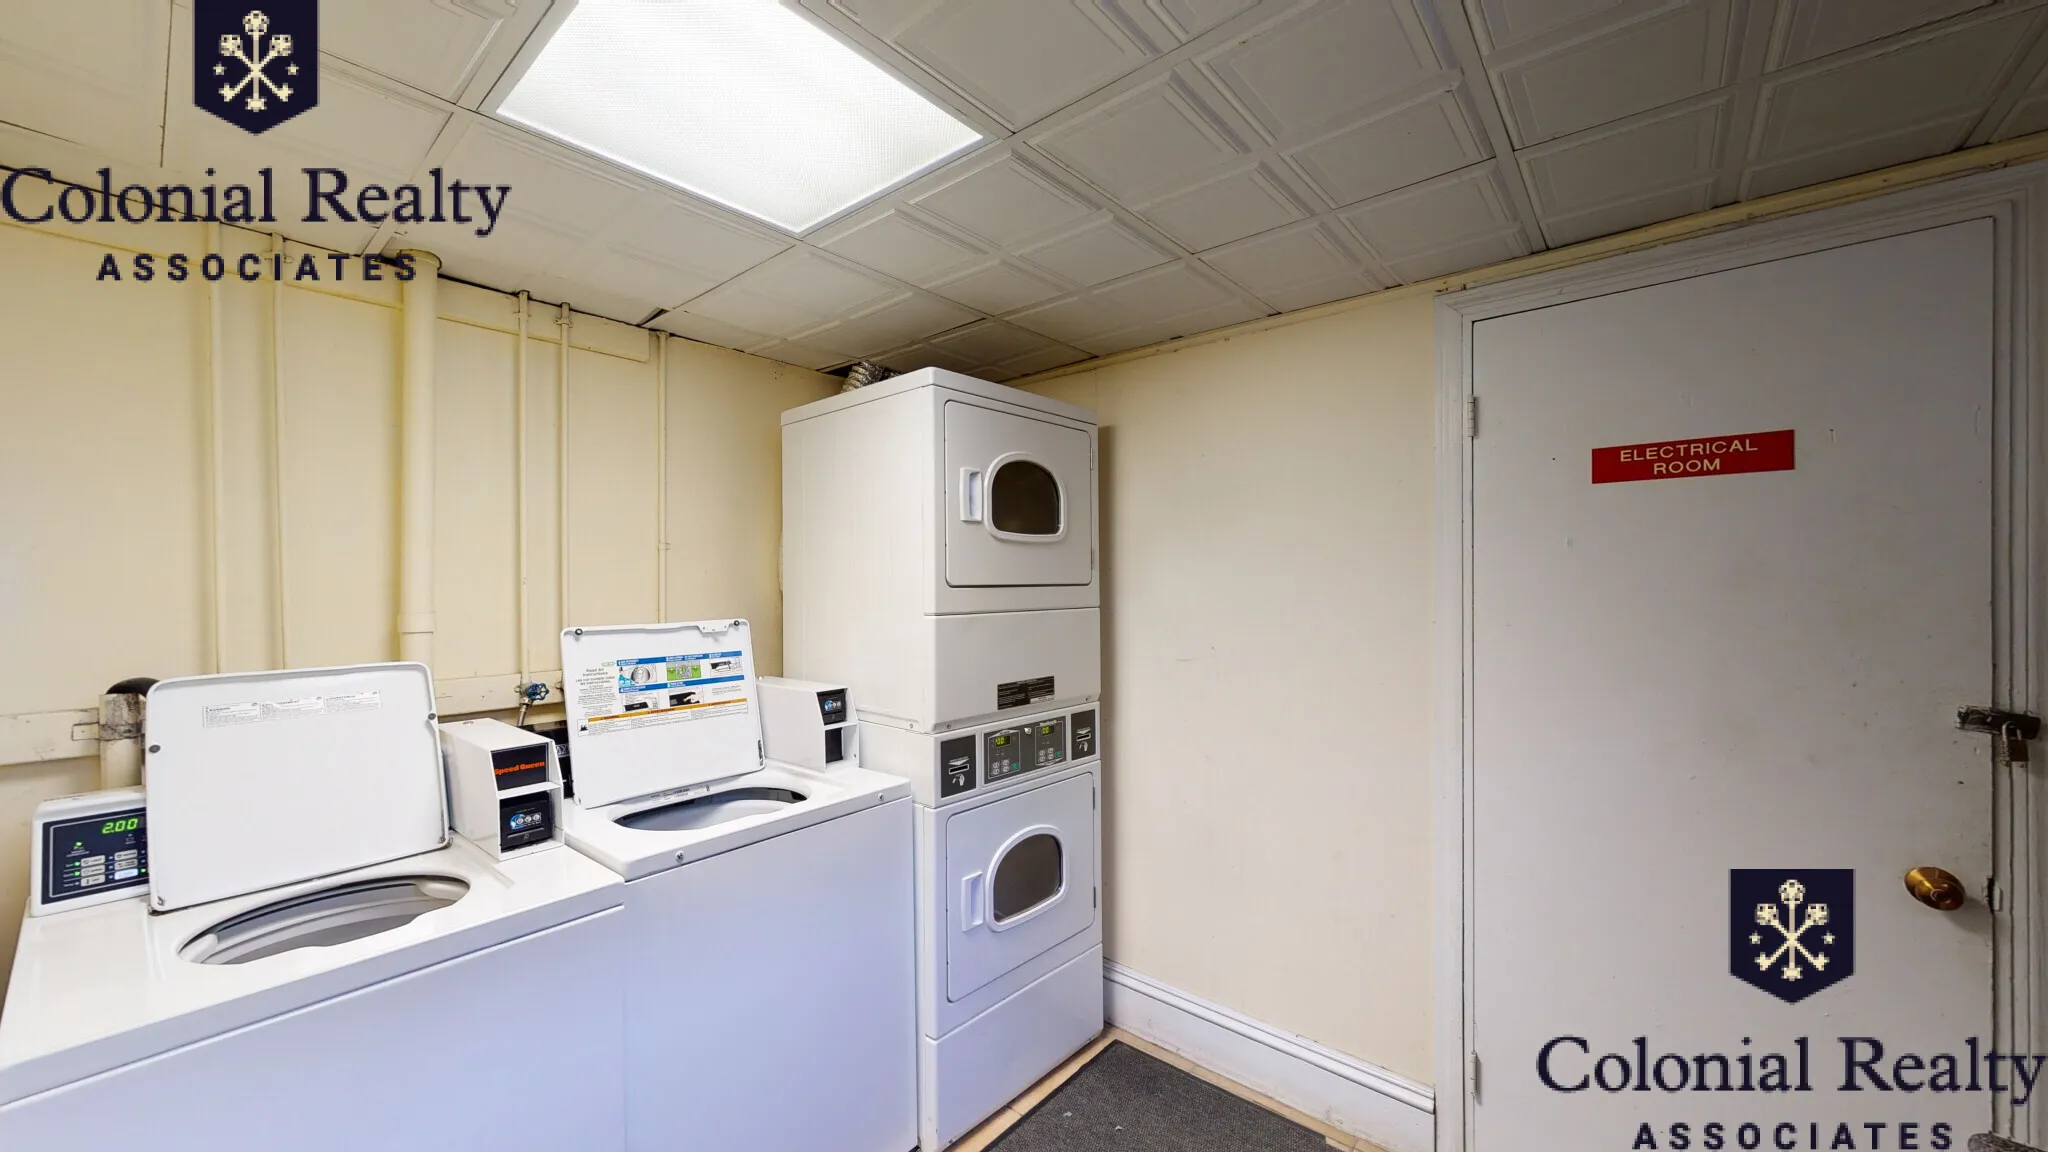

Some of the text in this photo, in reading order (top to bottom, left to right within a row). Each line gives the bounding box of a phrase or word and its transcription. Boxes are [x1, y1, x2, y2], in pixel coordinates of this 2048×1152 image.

[1620, 439, 1758, 462] ELECTRICAL
[1653, 458, 1721, 475] ROOM
[494, 761, 546, 775] Speed Queen
[102, 818, 139, 834] 2.00
